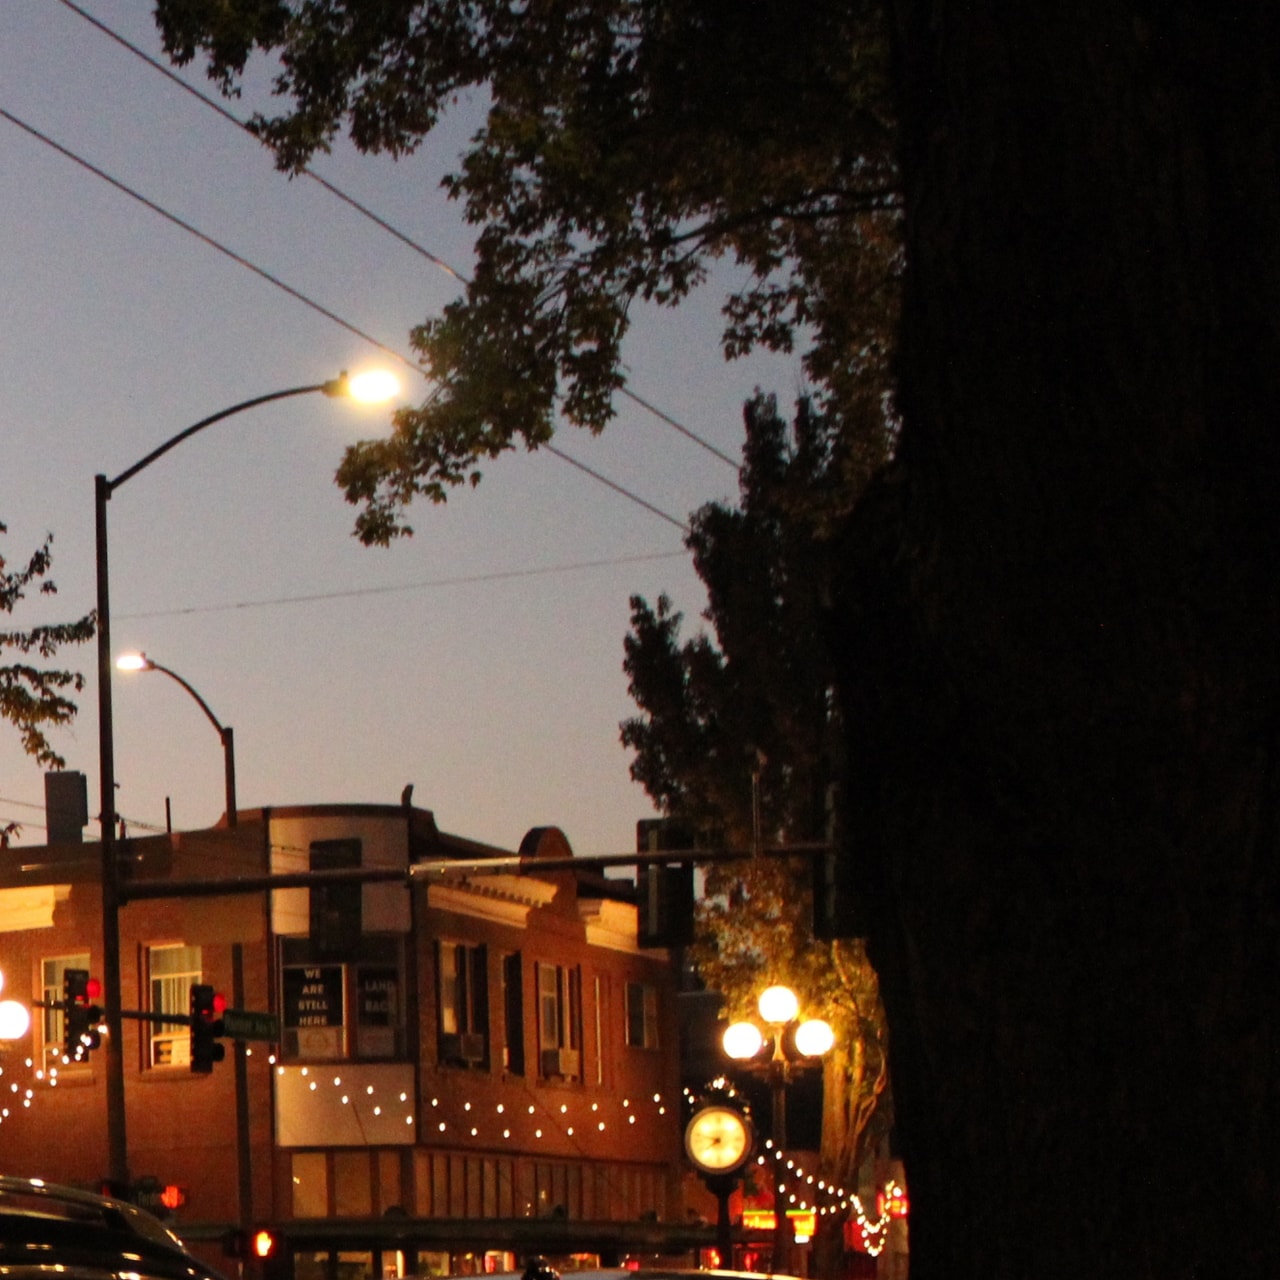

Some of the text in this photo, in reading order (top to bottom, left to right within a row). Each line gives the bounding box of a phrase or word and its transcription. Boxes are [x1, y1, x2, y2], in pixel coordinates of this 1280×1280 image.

[303, 967, 322, 979] WE
[302, 983, 325, 995] ARE
[297, 999, 329, 1011] STILL
[299, 1015, 328, 1026] HERE
